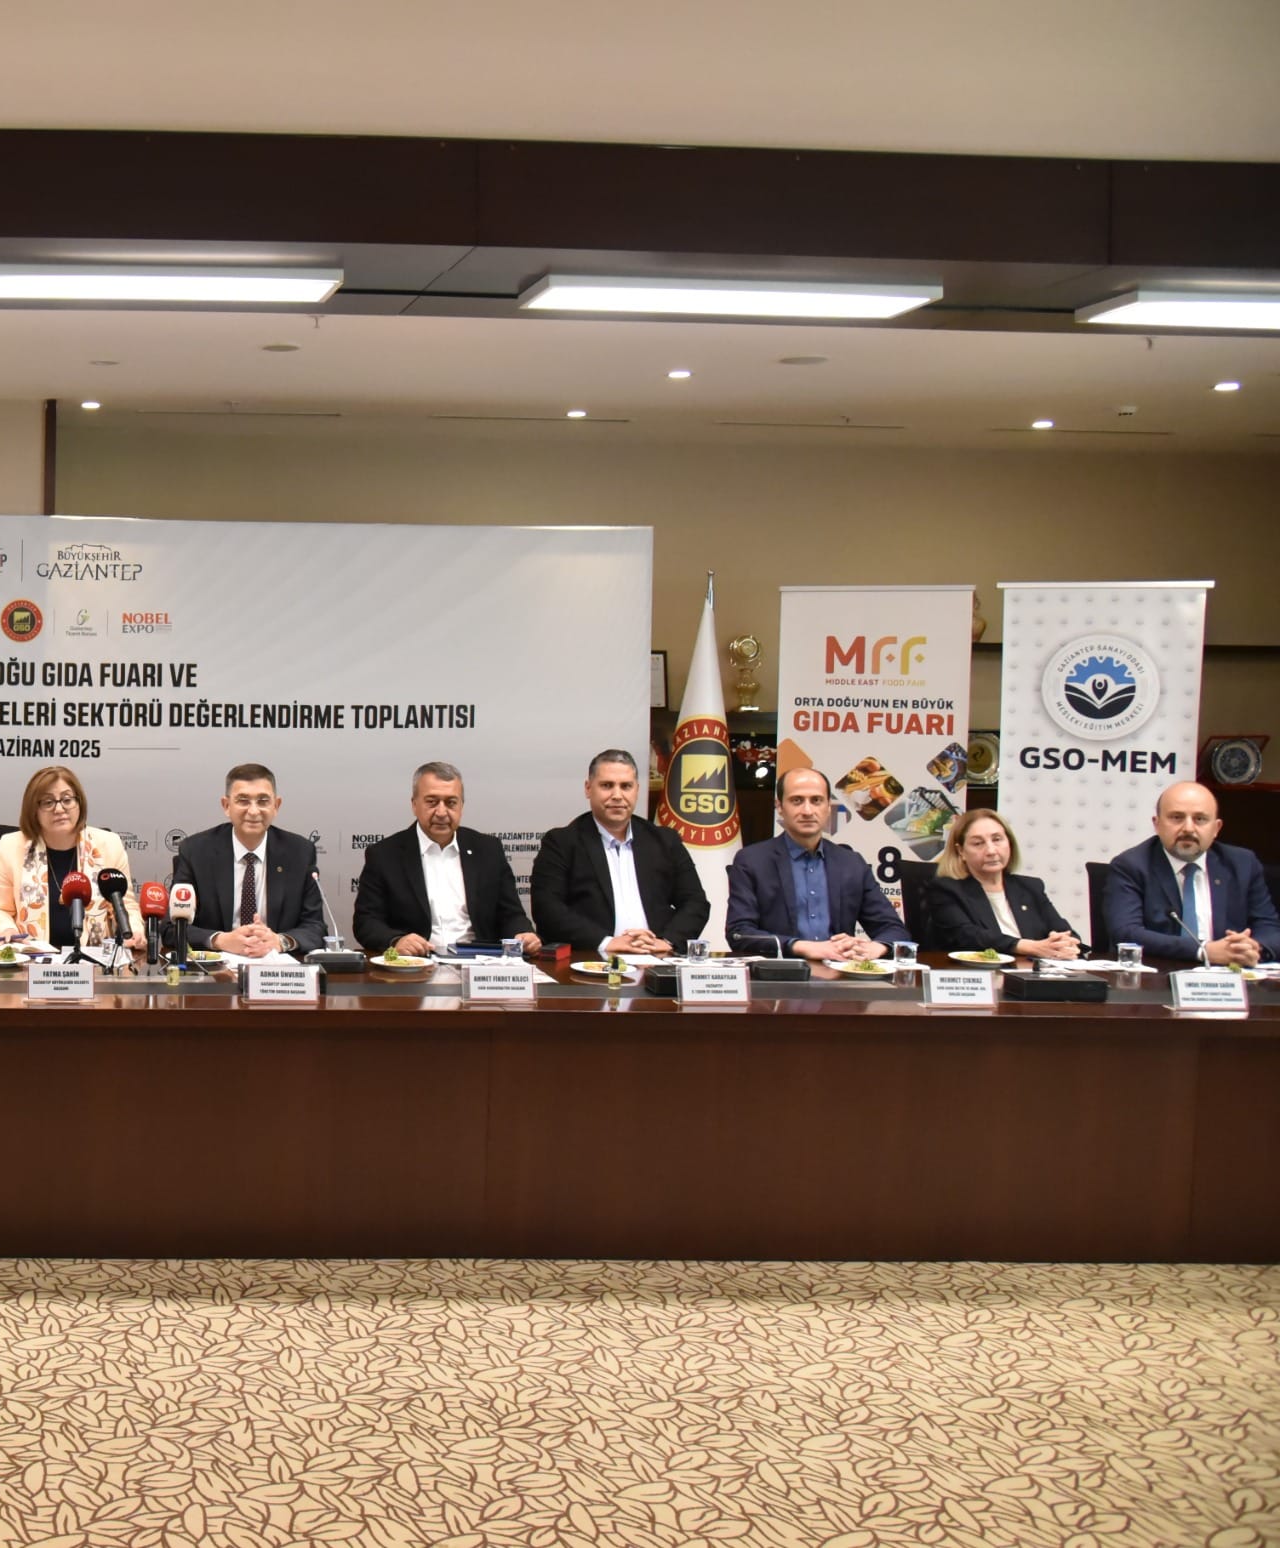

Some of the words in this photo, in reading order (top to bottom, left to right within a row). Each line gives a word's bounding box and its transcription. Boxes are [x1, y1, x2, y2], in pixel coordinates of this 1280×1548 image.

[122, 613, 173, 625] NOBEL
[122, 625, 154, 634] EXPO
[42, 662, 93, 687] GIDA
[100, 663, 163, 687] FUARI
[169, 663, 198, 688] VE
[825, 678, 856, 686] MIDDLE
[857, 678, 879, 686] EAST
[794, 697, 824, 707] ORTA
[892, 699, 909, 709] EN
[912, 697, 954, 710] BÜYÜK
[63, 699, 163, 727] SEKTÖRÜ
[169, 699, 344, 729] DEĞERLENDİRME
[351, 704, 476, 729] TOPLANTISI
[793, 710, 860, 733] GIDA
[867, 712, 954, 736] FUARI
[60, 740, 100, 758] 2025
[1020, 746, 1176, 774] GSO-MEM
[680, 793, 730, 814] GSO
